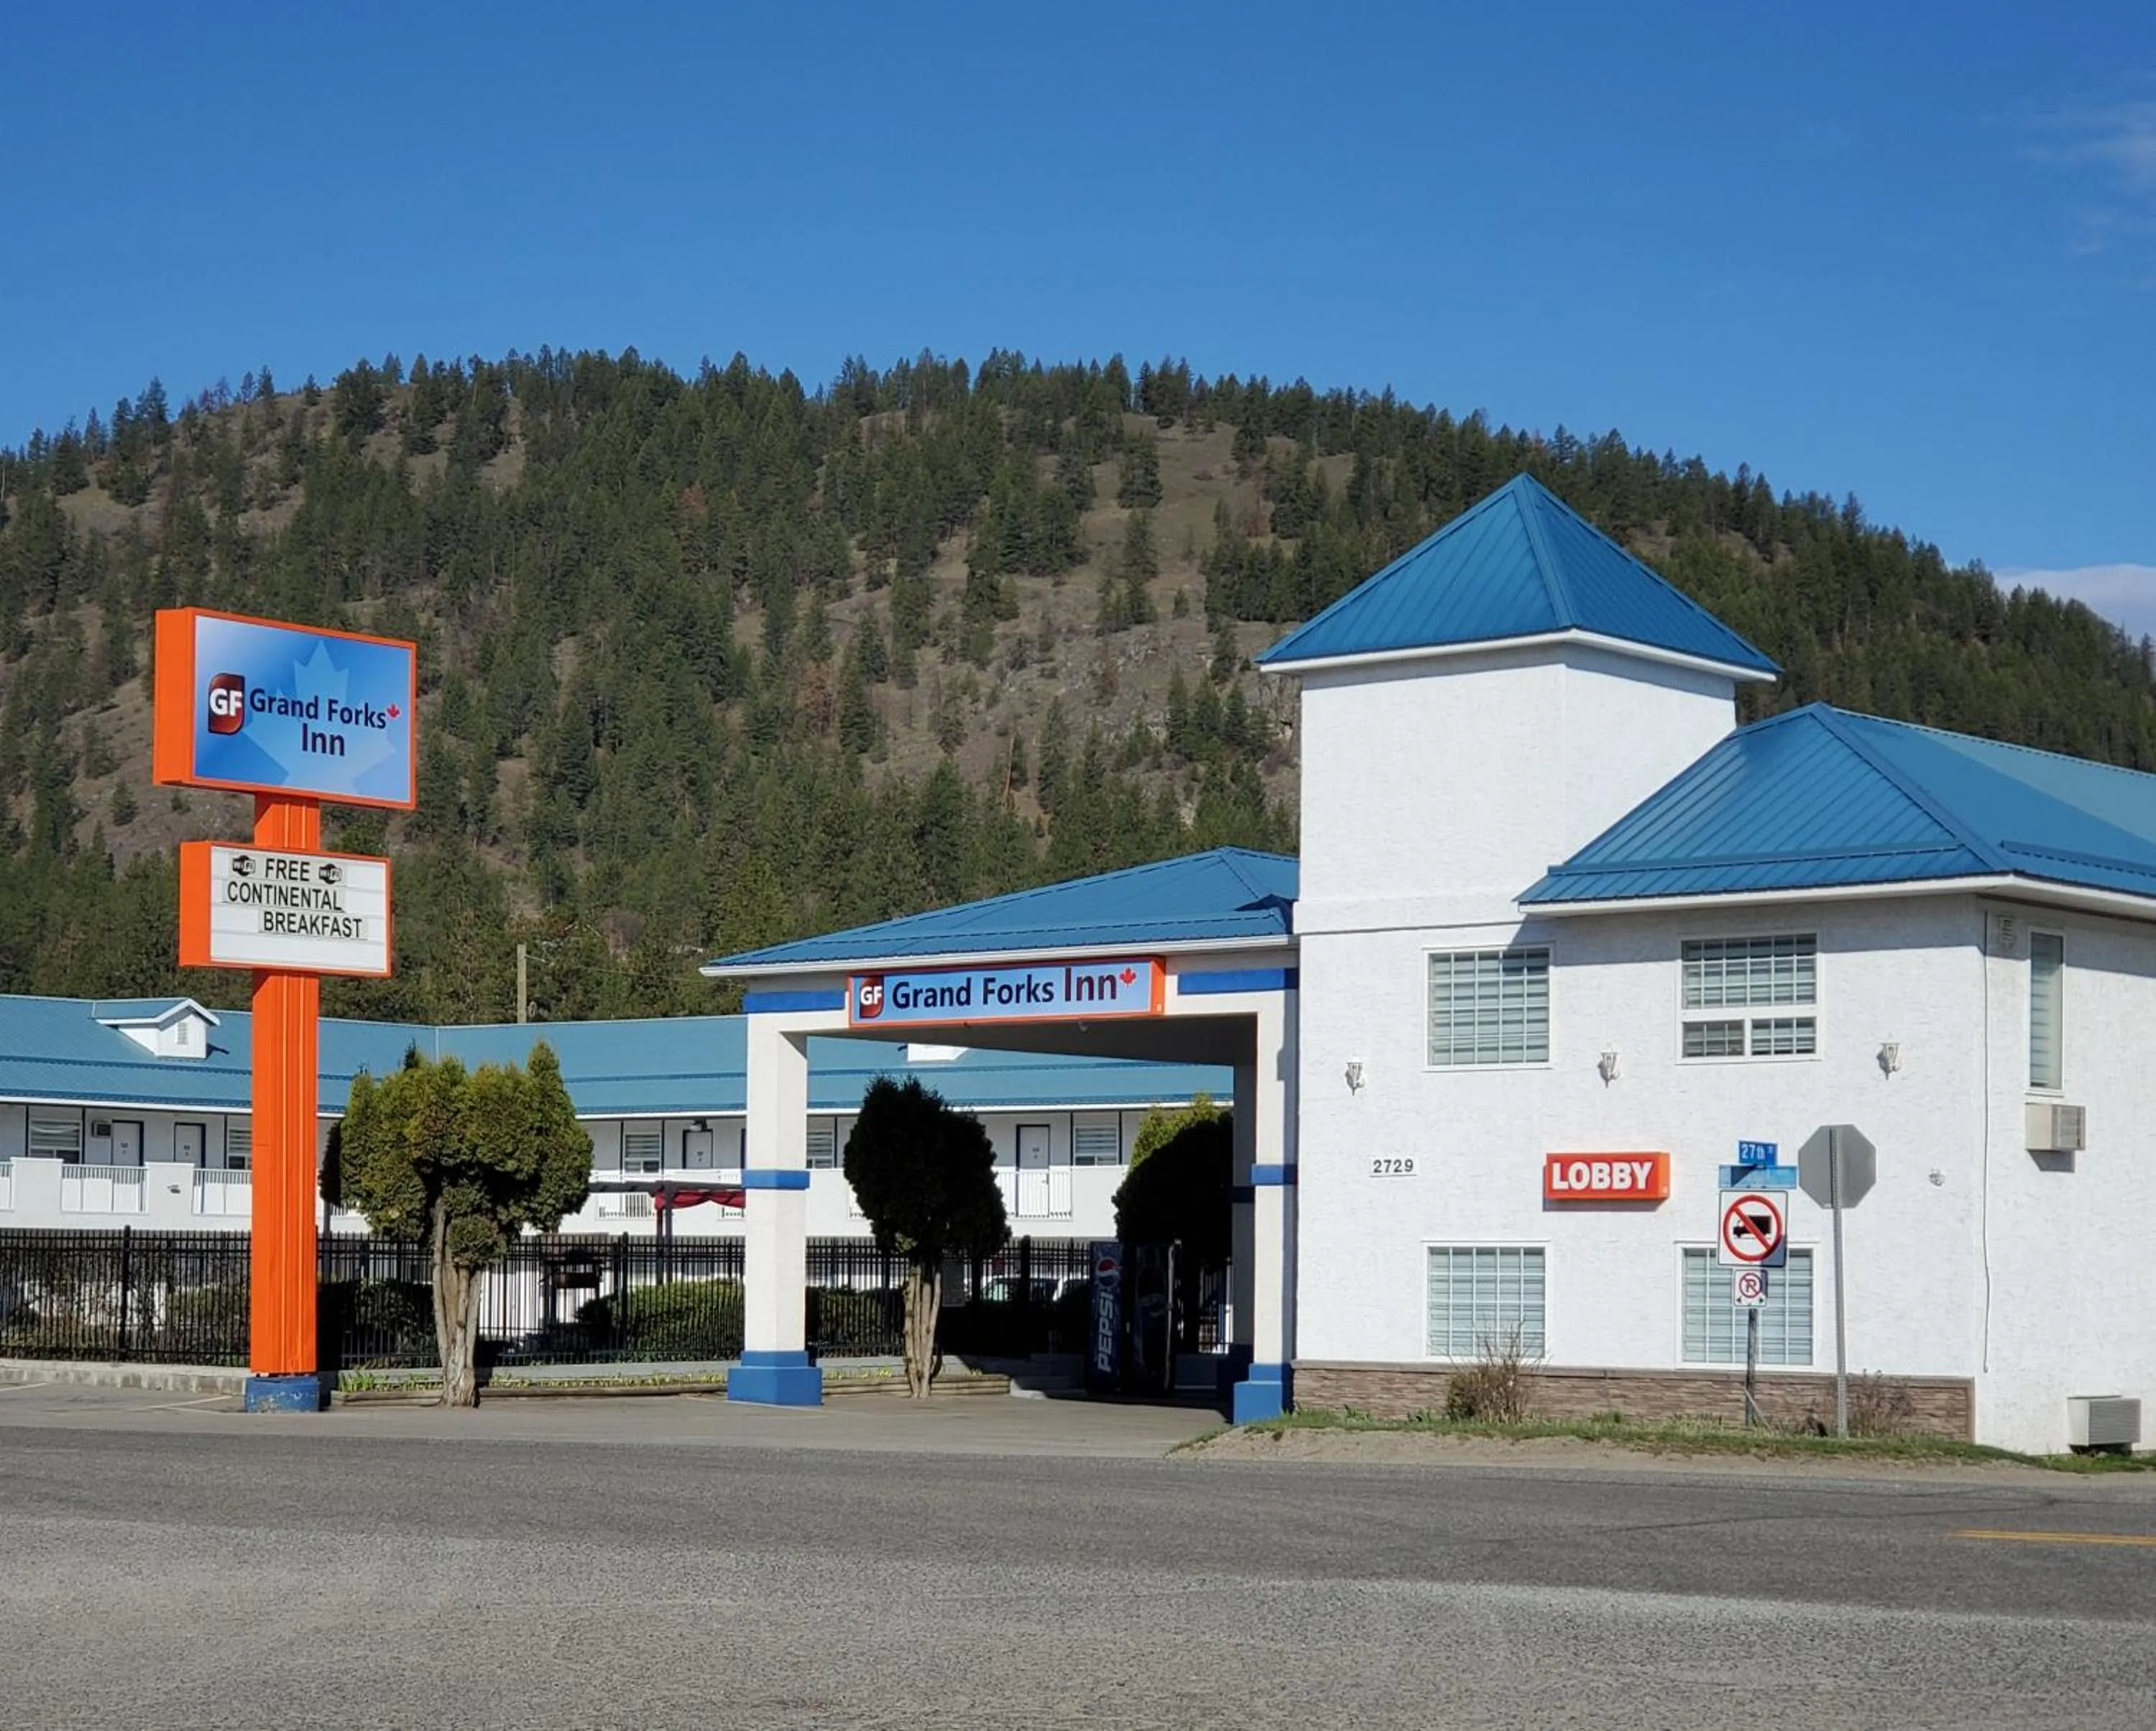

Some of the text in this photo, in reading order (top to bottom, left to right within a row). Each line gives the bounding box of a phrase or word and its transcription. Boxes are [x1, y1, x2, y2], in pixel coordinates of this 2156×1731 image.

[209, 688, 242, 716] GF
[249, 688, 387, 729] Grand Forks
[302, 723, 345, 756] Inn
[265, 858, 310, 881] FREE
[227, 881, 343, 911] CONTINENTAL
[264, 910, 362, 938] BREAKFAST
[861, 985, 883, 1005] GF
[893, 967, 1116, 1009] Grand Forks Inn
[1373, 1159, 1414, 1173] 2729
[1552, 1161, 1652, 1190] LOBBY
[1097, 1292, 1114, 1373] PEPSI
